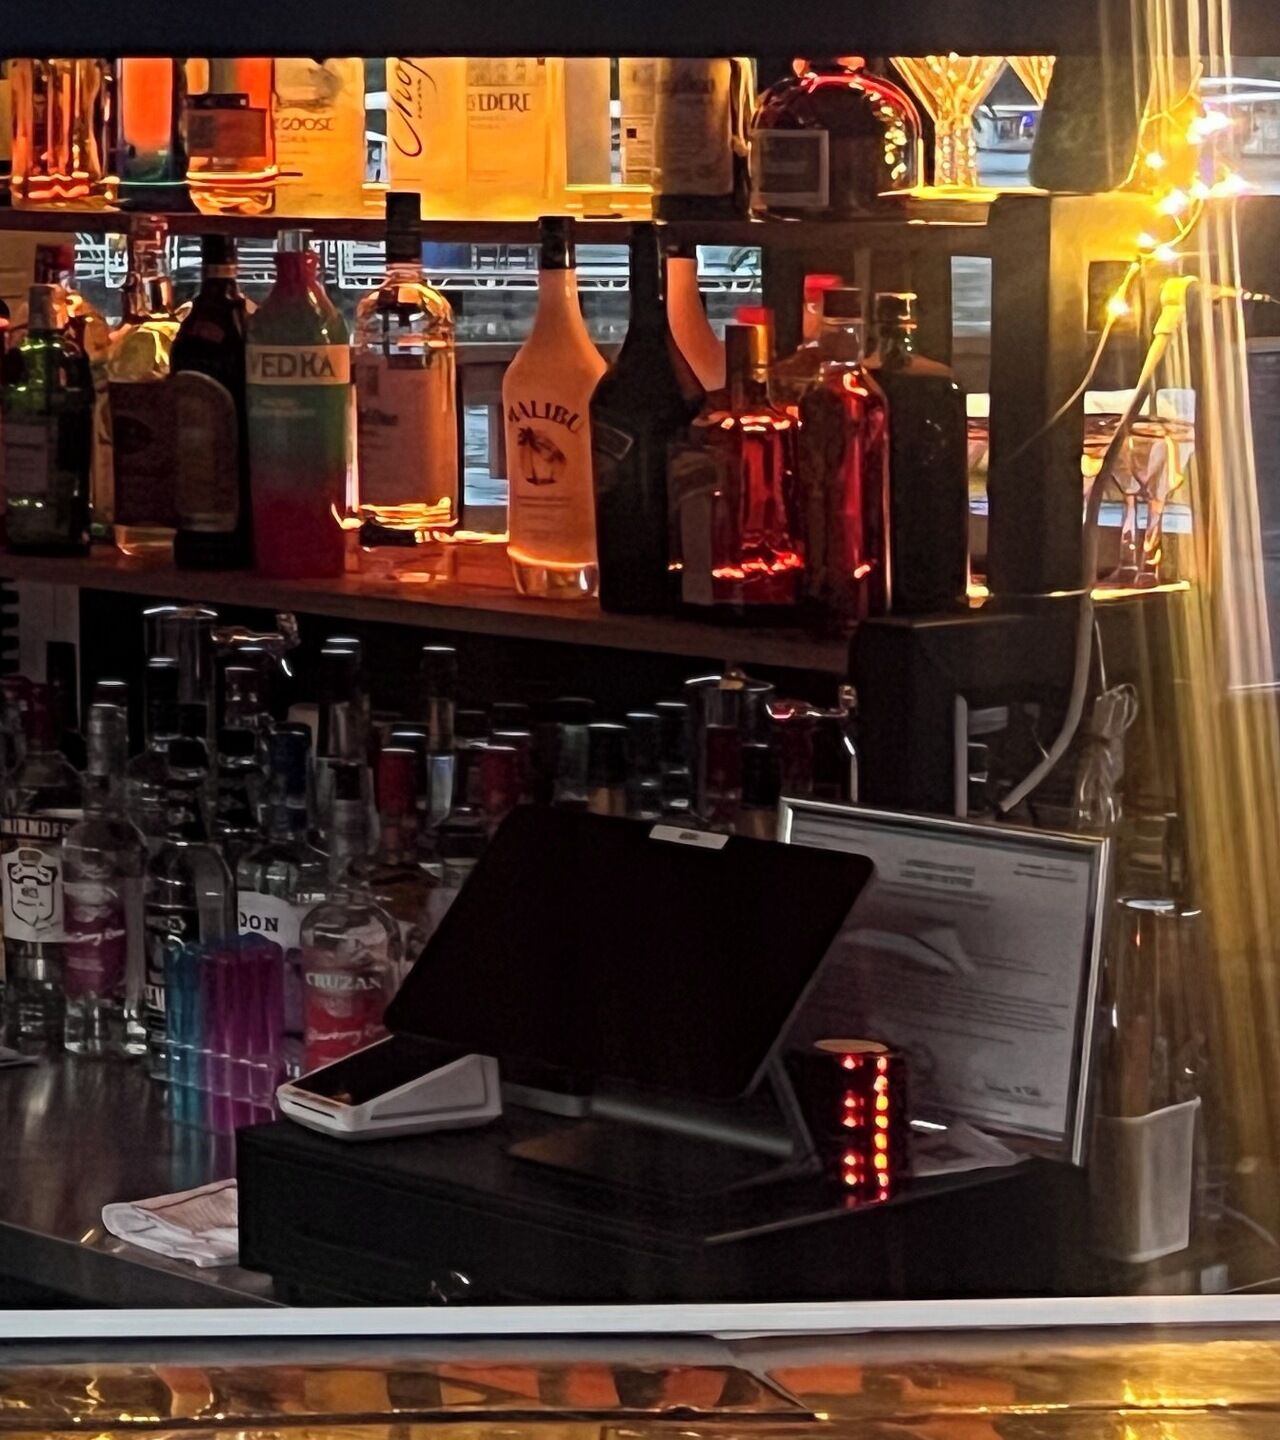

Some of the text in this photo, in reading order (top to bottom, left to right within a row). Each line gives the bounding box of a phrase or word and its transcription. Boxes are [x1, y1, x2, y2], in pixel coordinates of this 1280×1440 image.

[468, 92, 533, 113] EDERE
[248, 352, 337, 379] VEDKA
[305, 971, 382, 991] CRUZAN
